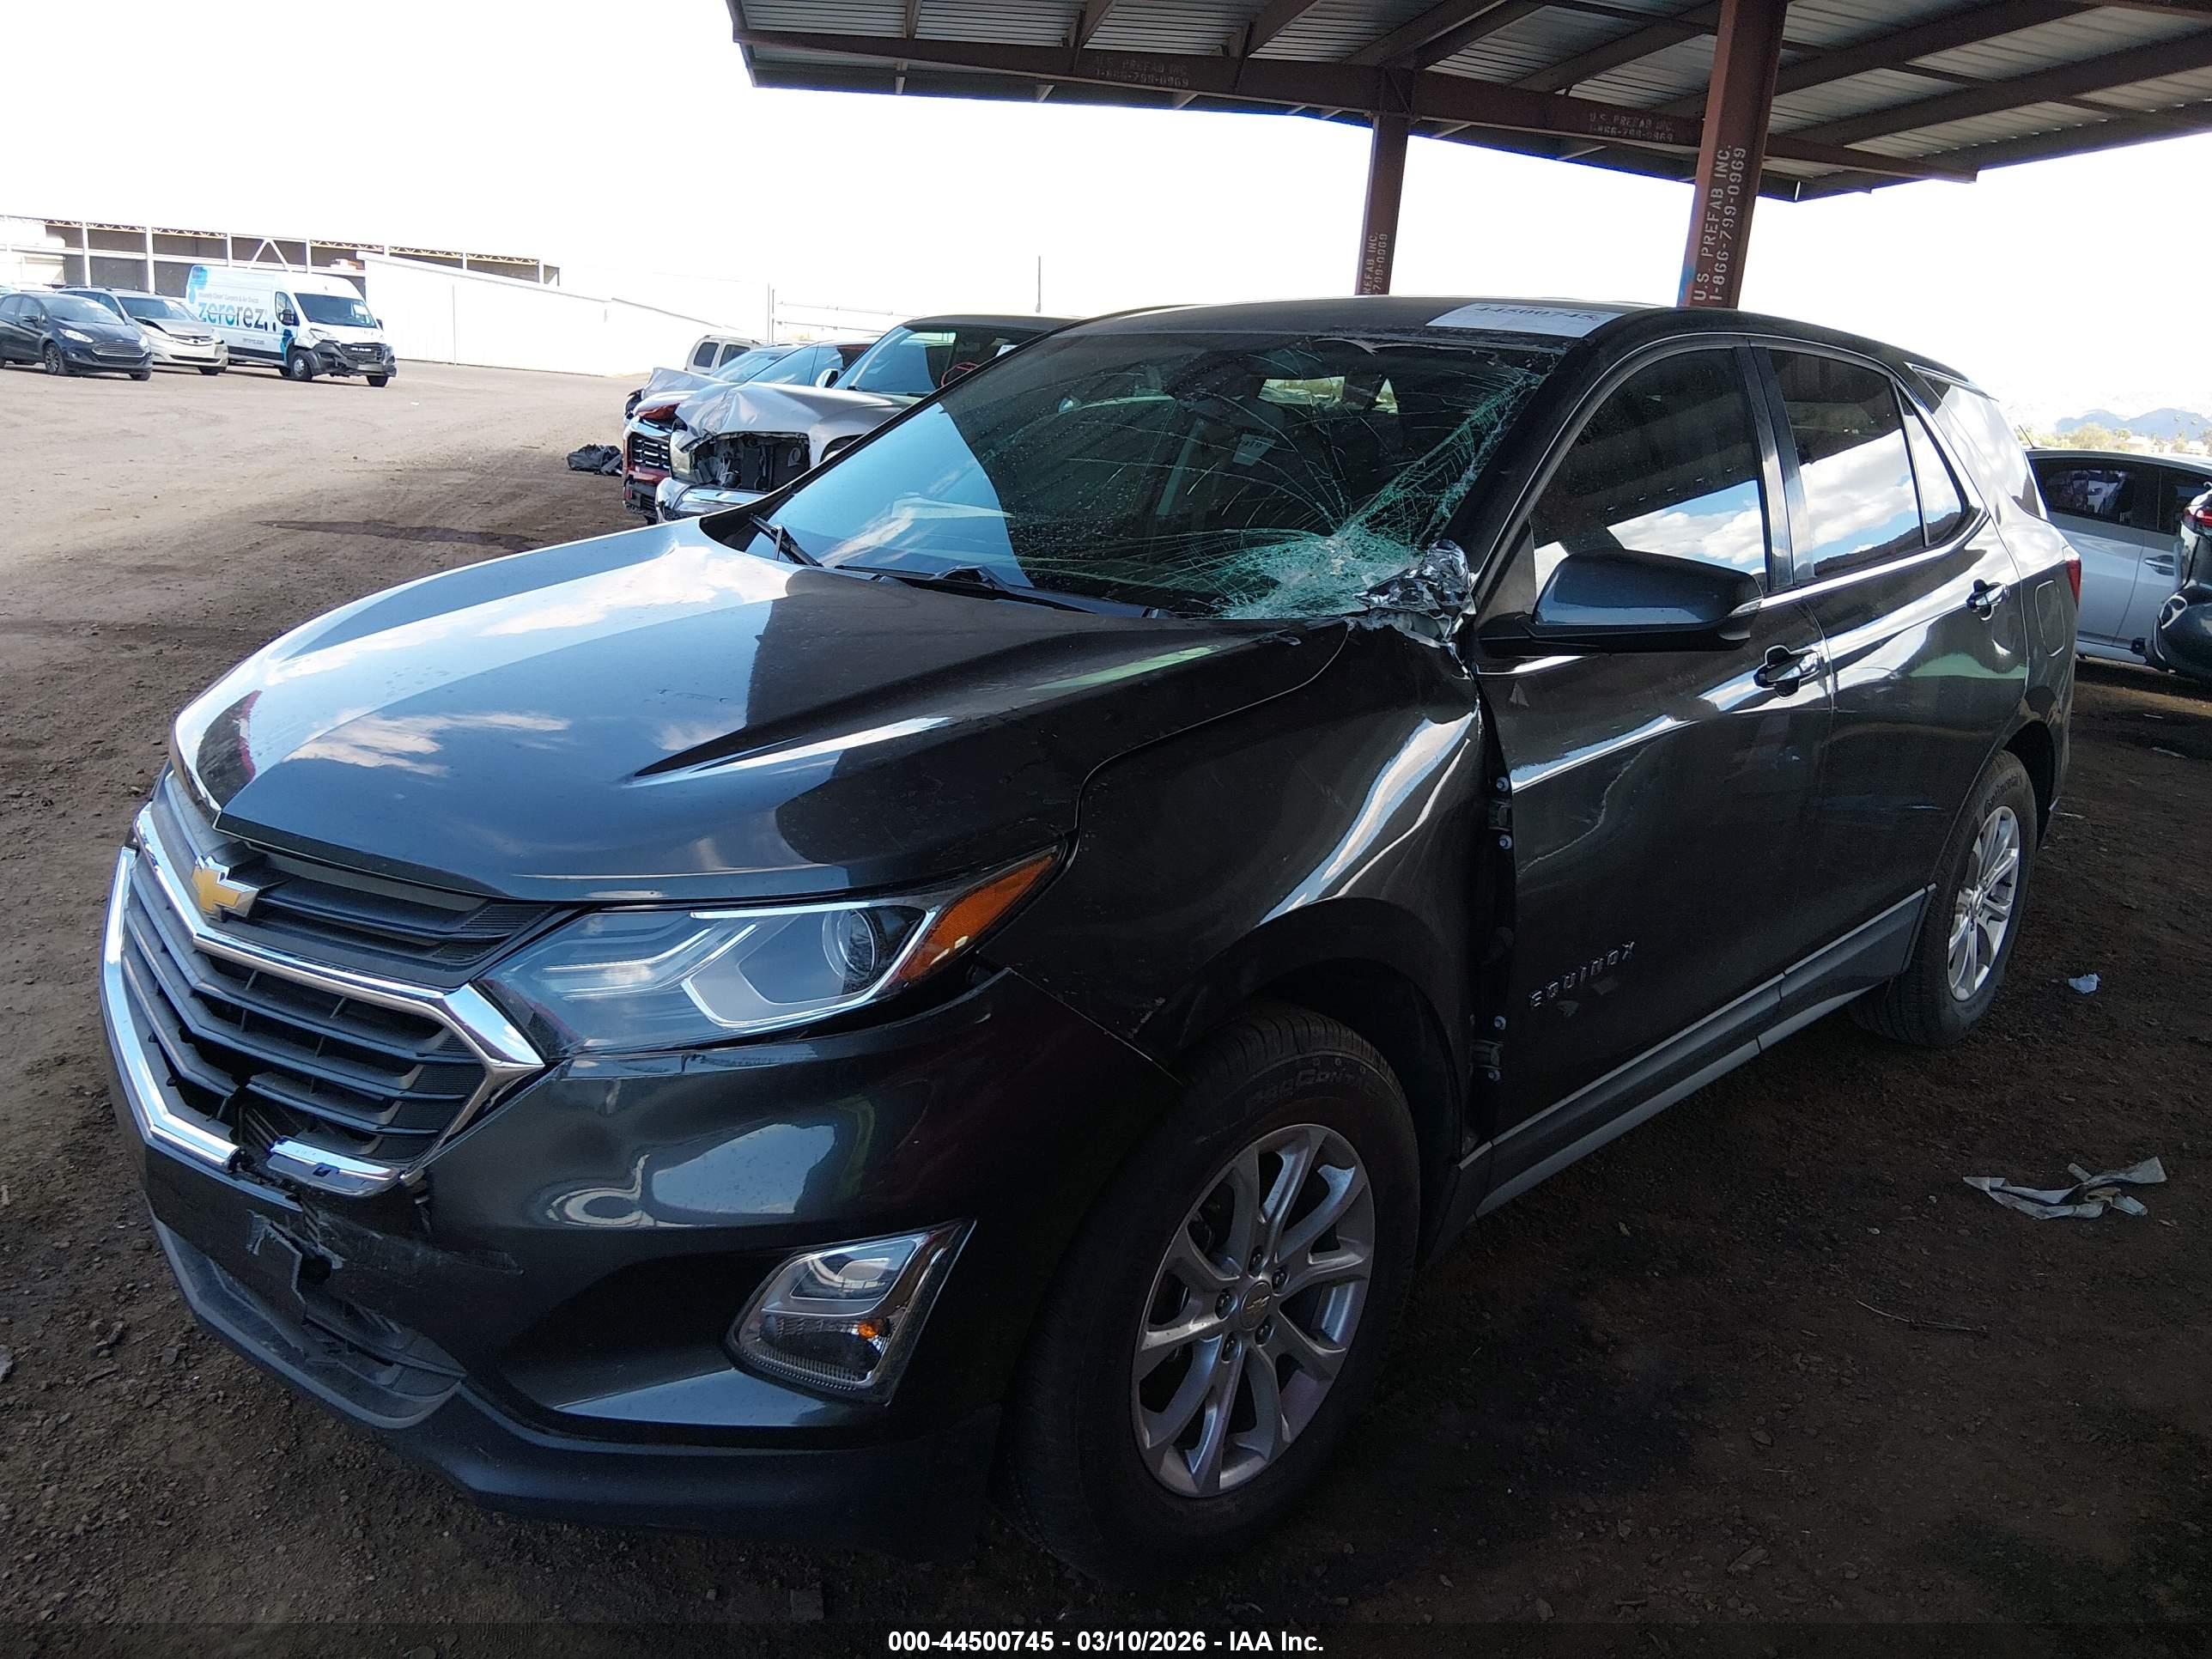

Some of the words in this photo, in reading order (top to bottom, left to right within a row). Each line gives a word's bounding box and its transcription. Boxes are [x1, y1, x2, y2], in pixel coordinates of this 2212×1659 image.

[1714, 145, 1731, 179] INC.
[1701, 187, 1724, 257] PREFAB
[1709, 148, 1747, 301] 1-866-799-0969
[1366, 232, 1379, 253] INC.
[1693, 268, 1711, 301] U.S.
[198, 301, 265, 330] zerorez
[1529, 940, 1635, 1010] EQUINOX
